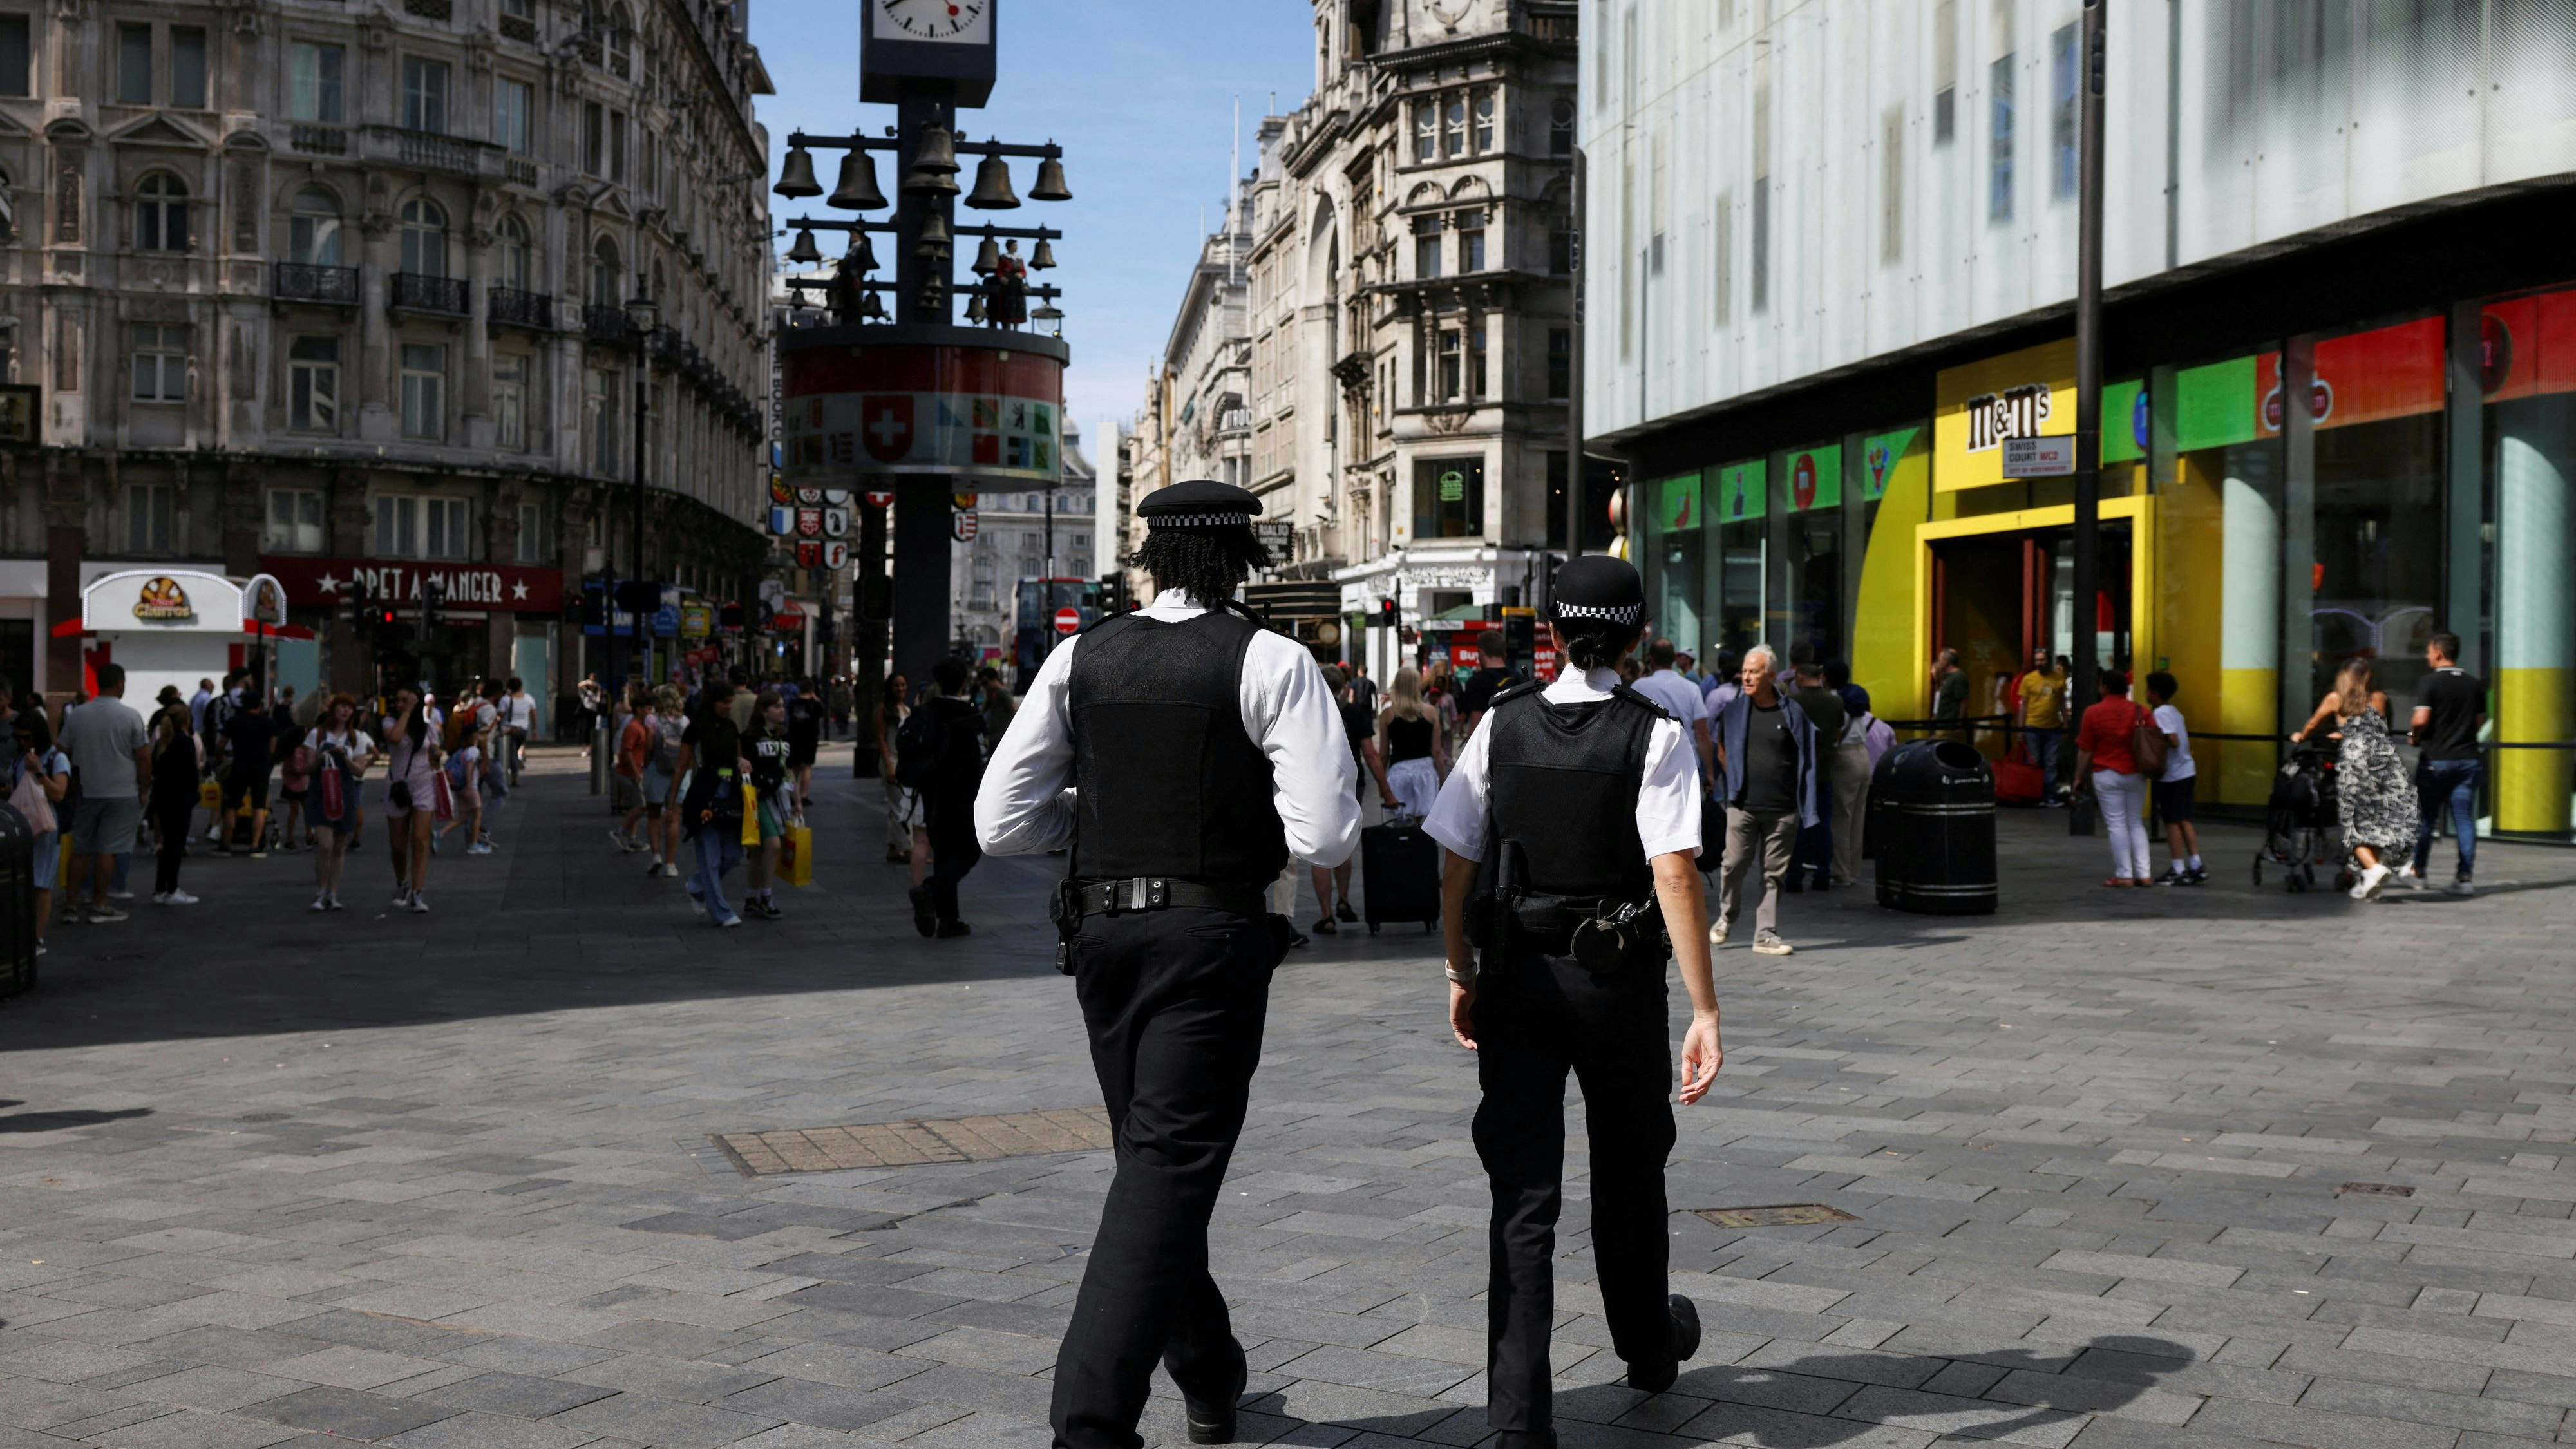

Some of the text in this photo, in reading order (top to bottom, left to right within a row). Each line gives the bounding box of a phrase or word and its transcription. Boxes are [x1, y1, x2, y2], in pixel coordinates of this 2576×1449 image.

[772, 379, 782, 423] BOOK
[2009, 440, 2037, 451] SWISS
[2009, 450, 2059, 462] COURT WC2
[352, 567, 403, 600] PRET
[409, 569, 422, 601] A
